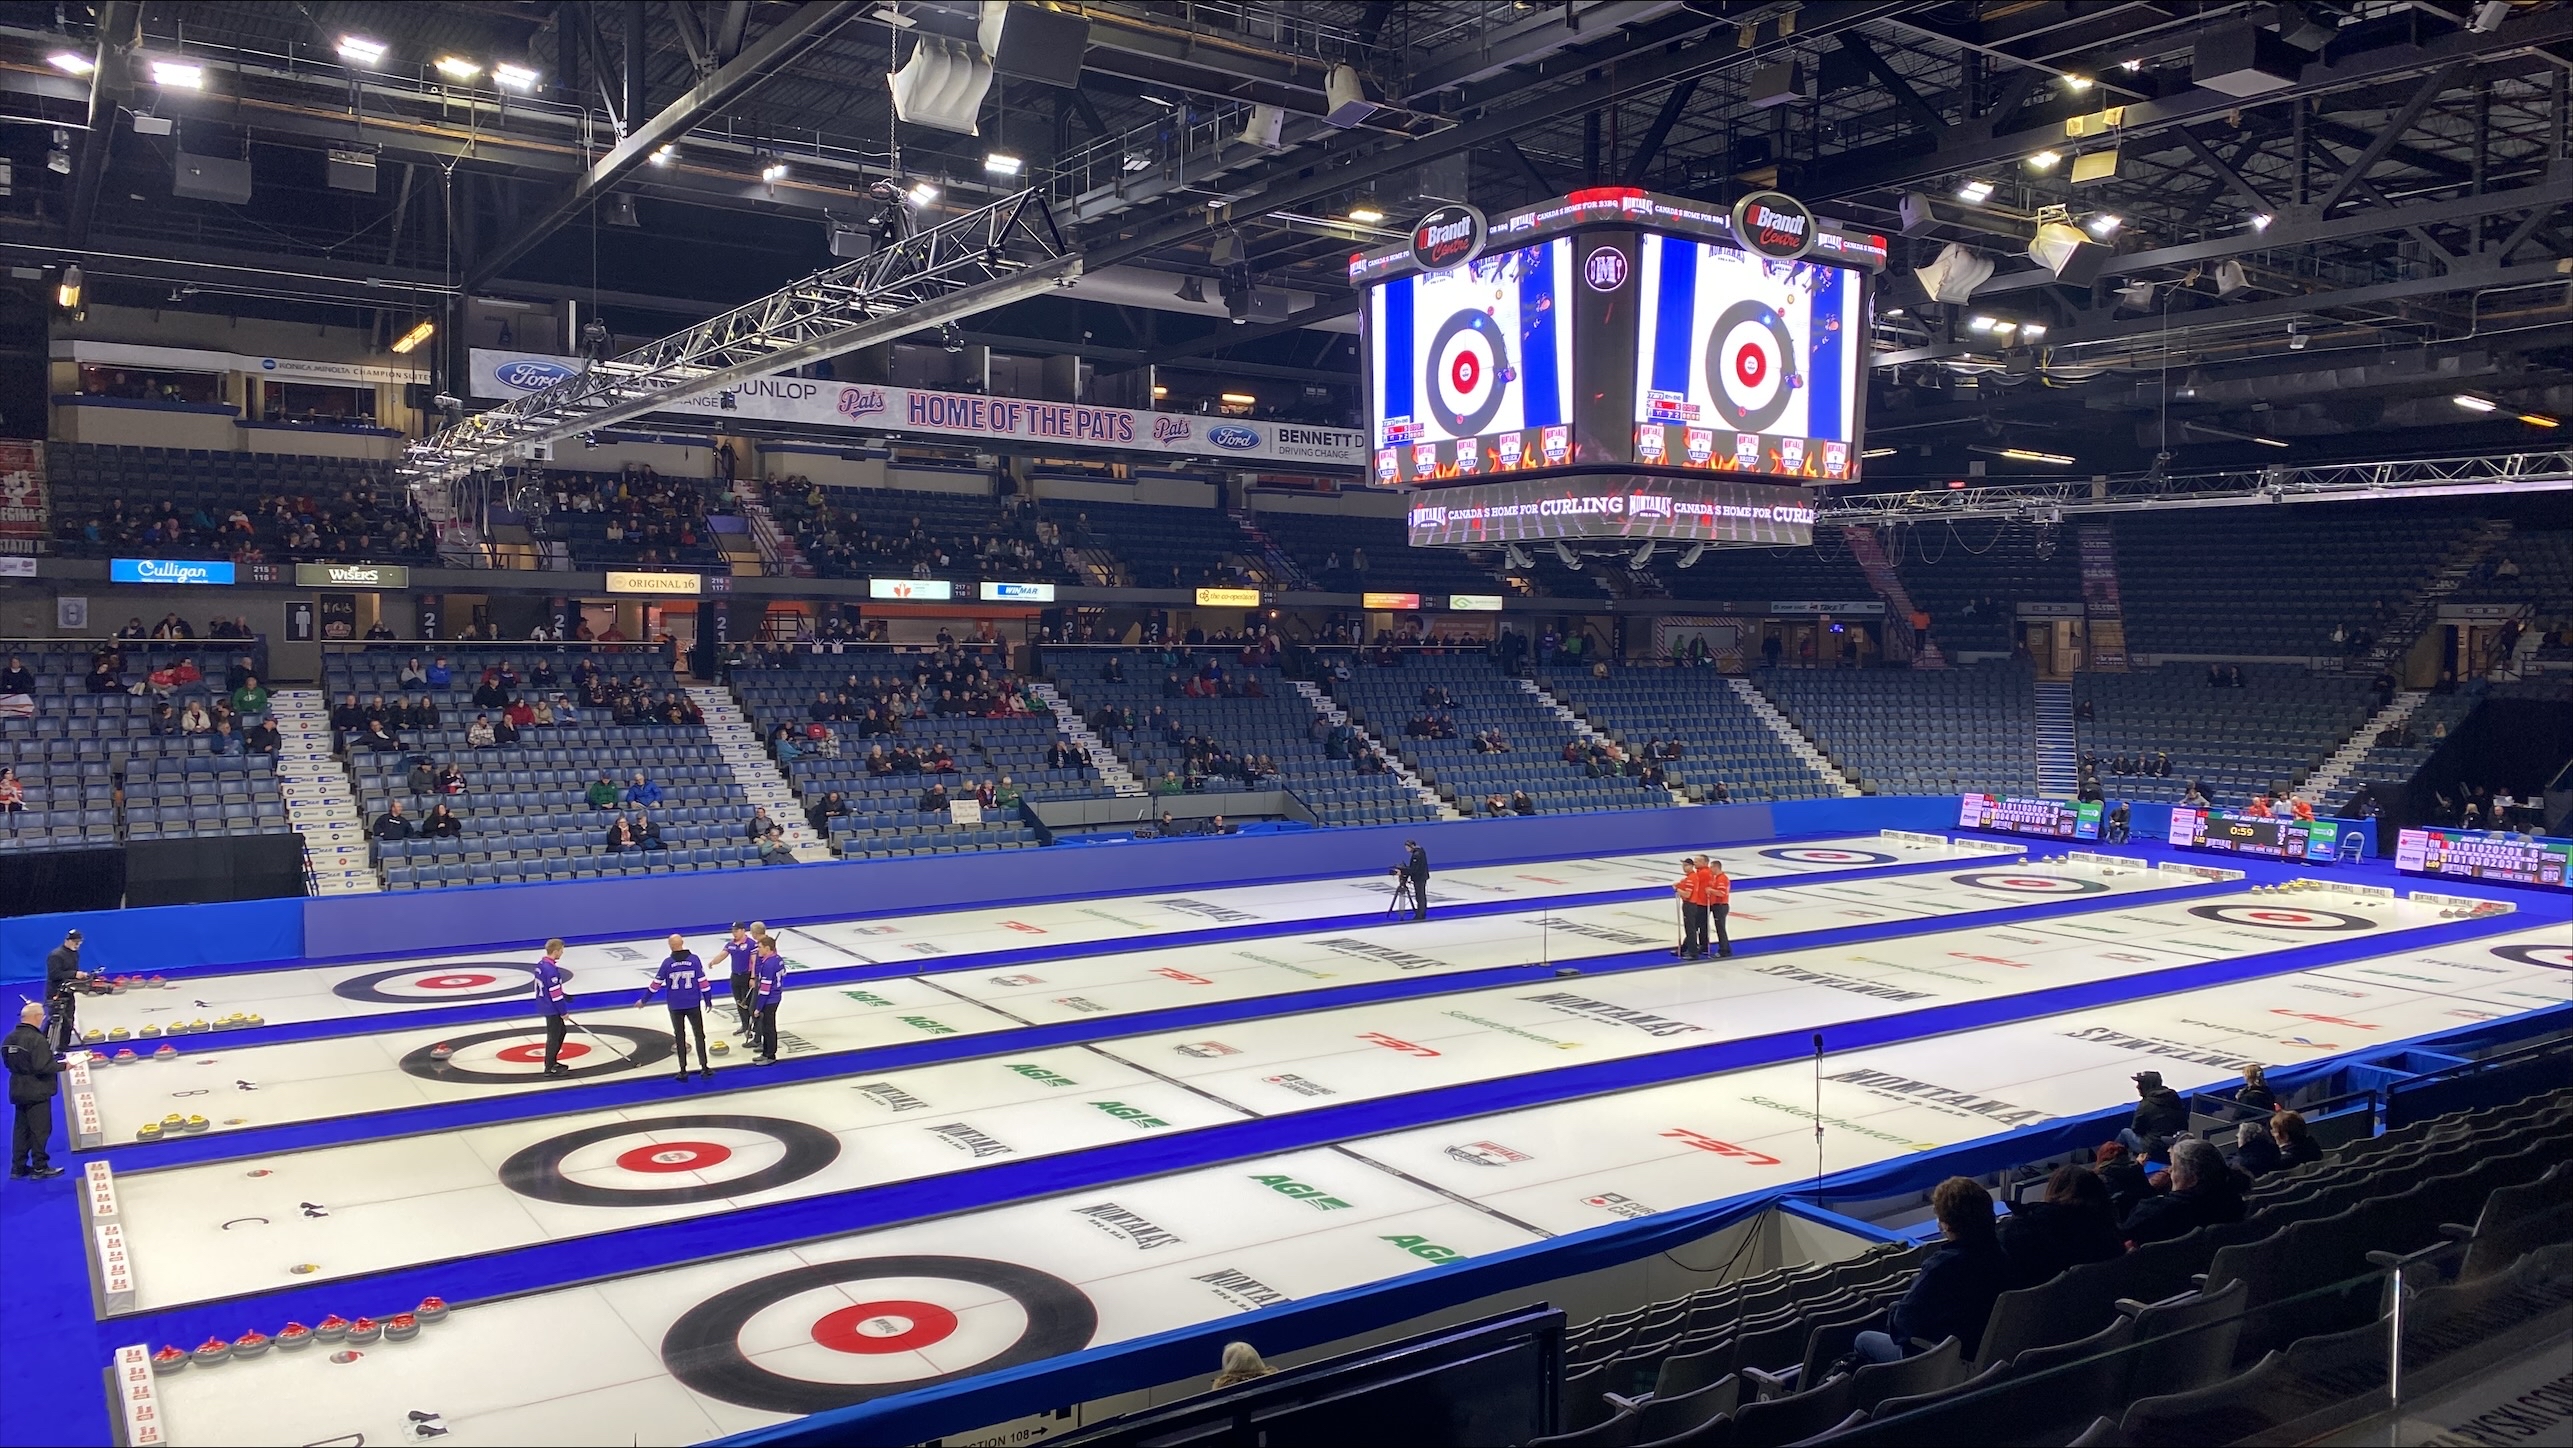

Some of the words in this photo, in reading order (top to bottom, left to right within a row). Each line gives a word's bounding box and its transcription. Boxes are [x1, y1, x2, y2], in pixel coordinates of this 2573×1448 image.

[1428, 215, 1471, 247] Brandt
[1757, 207, 1806, 236] Brandt
[1760, 227, 1801, 248] Centre
[1432, 238, 1469, 262] Centre
[279, 362, 312, 371] KONICA
[314, 365, 350, 374] MINOLTA
[353, 368, 401, 378] CHAMPION
[510, 361, 563, 389] Ford
[838, 386, 886, 421] Pats
[908, 391, 986, 429] HOME
[988, 397, 1023, 432] OF
[1024, 402, 1073, 437] THE
[1075, 408, 1135, 444] PATS
[1152, 415, 1192, 446] Pats
[1213, 426, 1254, 448] Ford
[1279, 429, 1352, 450] BENNETT
[1279, 447, 1313, 458] DRIVING
[1315, 449, 1349, 460] CHANGE
[1491, 505, 1518, 517] HOME
[1520, 504, 1538, 515] FOR
[1540, 496, 1623, 517] CURLING
[1723, 505, 1751, 517] HOME
[1752, 507, 1771, 518] FOR
[1773, 506, 1814, 525] CURLI
[138, 560, 207, 583] Culligan
[628, 578, 681, 589] ORIGINAL
[683, 578, 695, 589] 16
[1005, 586, 1038, 595] WINMAR
[2230, 826, 2254, 837] 0:59
[2280, 825, 2286, 833] 5
[2527, 863, 2538, 871] 10
[669, 970, 695, 990] YT
[2060, 1027, 2267, 1071] ONTANA'S
[1740, 1095, 1913, 1147] Saskatchewan
[923, 1122, 1019, 1158] MONTANA'S
[1658, 1128, 1782, 1166] TSN
[1248, 1174, 1332, 1203] AGI
[1070, 1202, 1187, 1251] MONTANA'S
[1190, 1268, 1291, 1305] MONTA
[1009, 1428, 1031, 1444] 108
